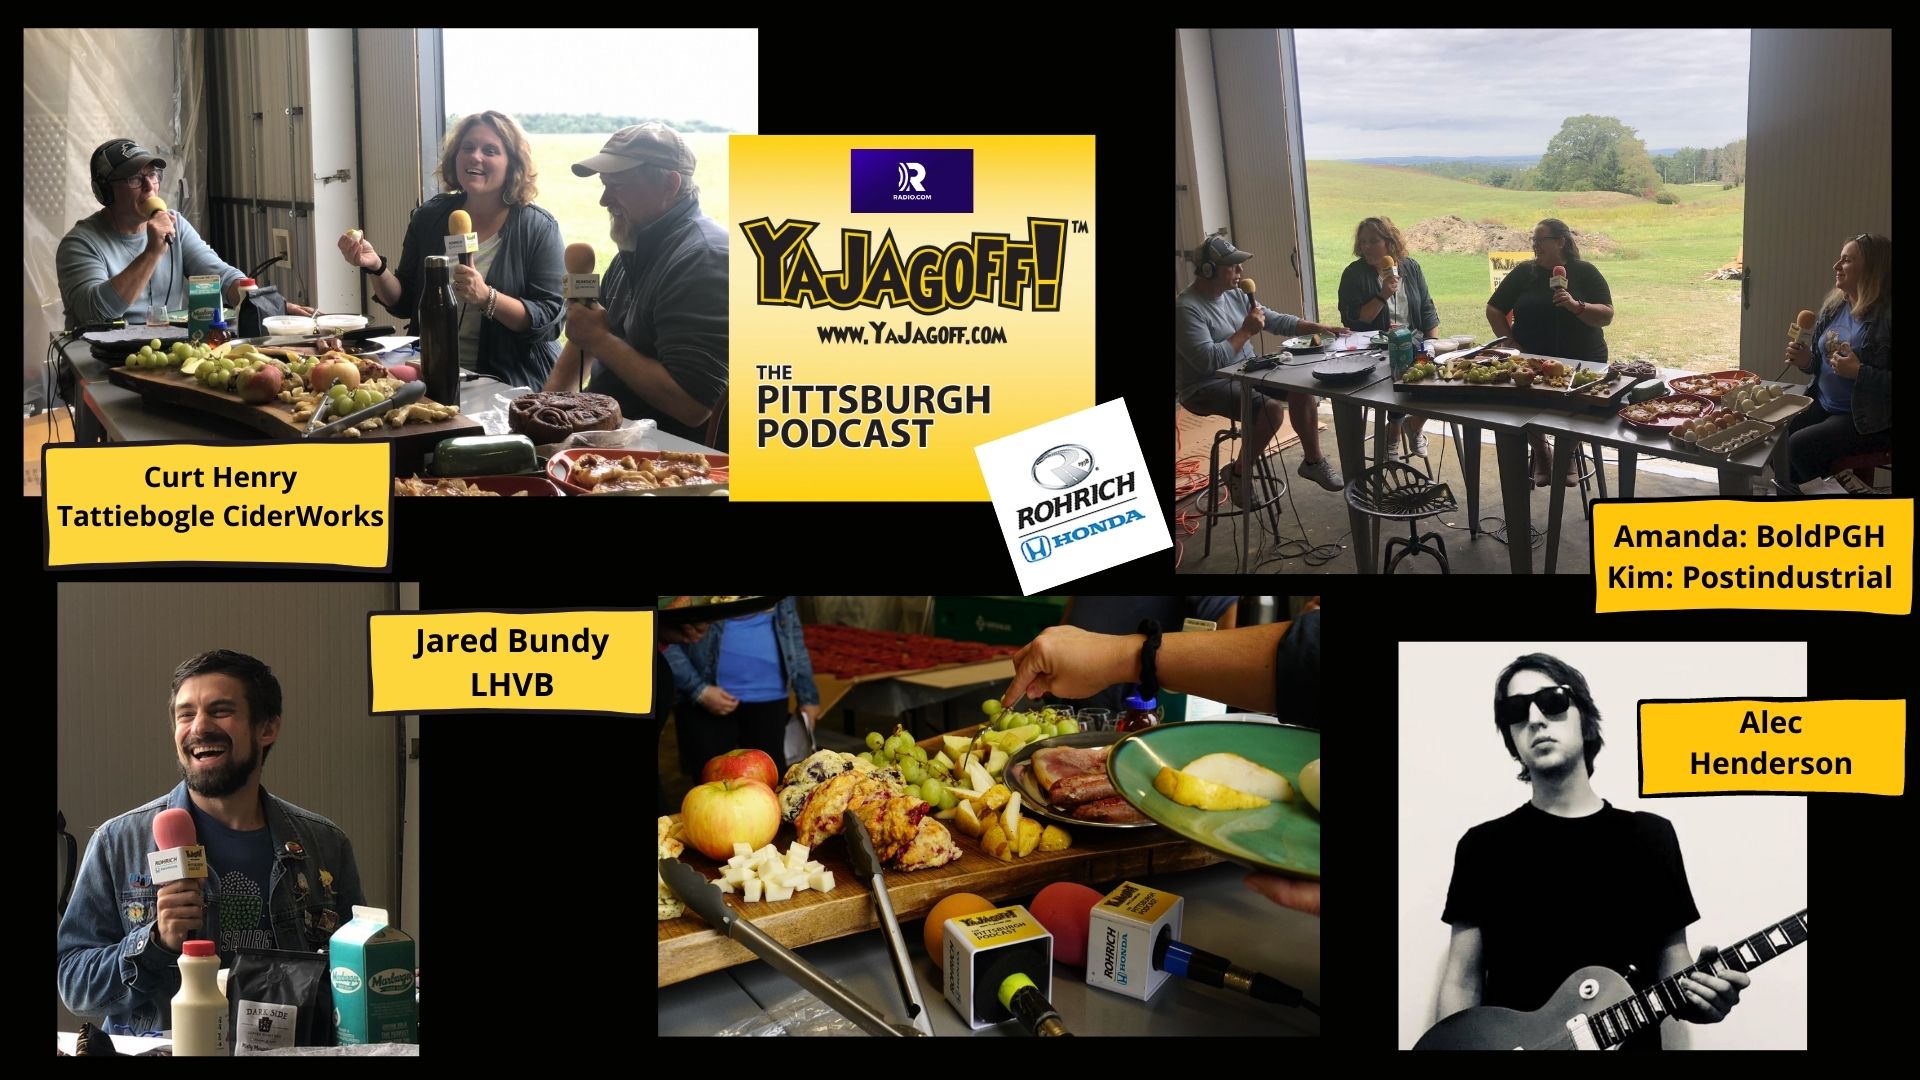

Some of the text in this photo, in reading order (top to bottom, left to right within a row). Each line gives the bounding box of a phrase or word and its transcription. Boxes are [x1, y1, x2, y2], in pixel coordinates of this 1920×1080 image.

[973, 922, 1027, 937] PITTSBURGH
[976, 928, 1017, 941] PODCAST
[220, 930, 273, 952] SBURG
[1104, 926, 1116, 980] ROHRICH
[1120, 933, 1128, 972] HONDA
[246, 1008, 288, 1020] DARK SIDE
